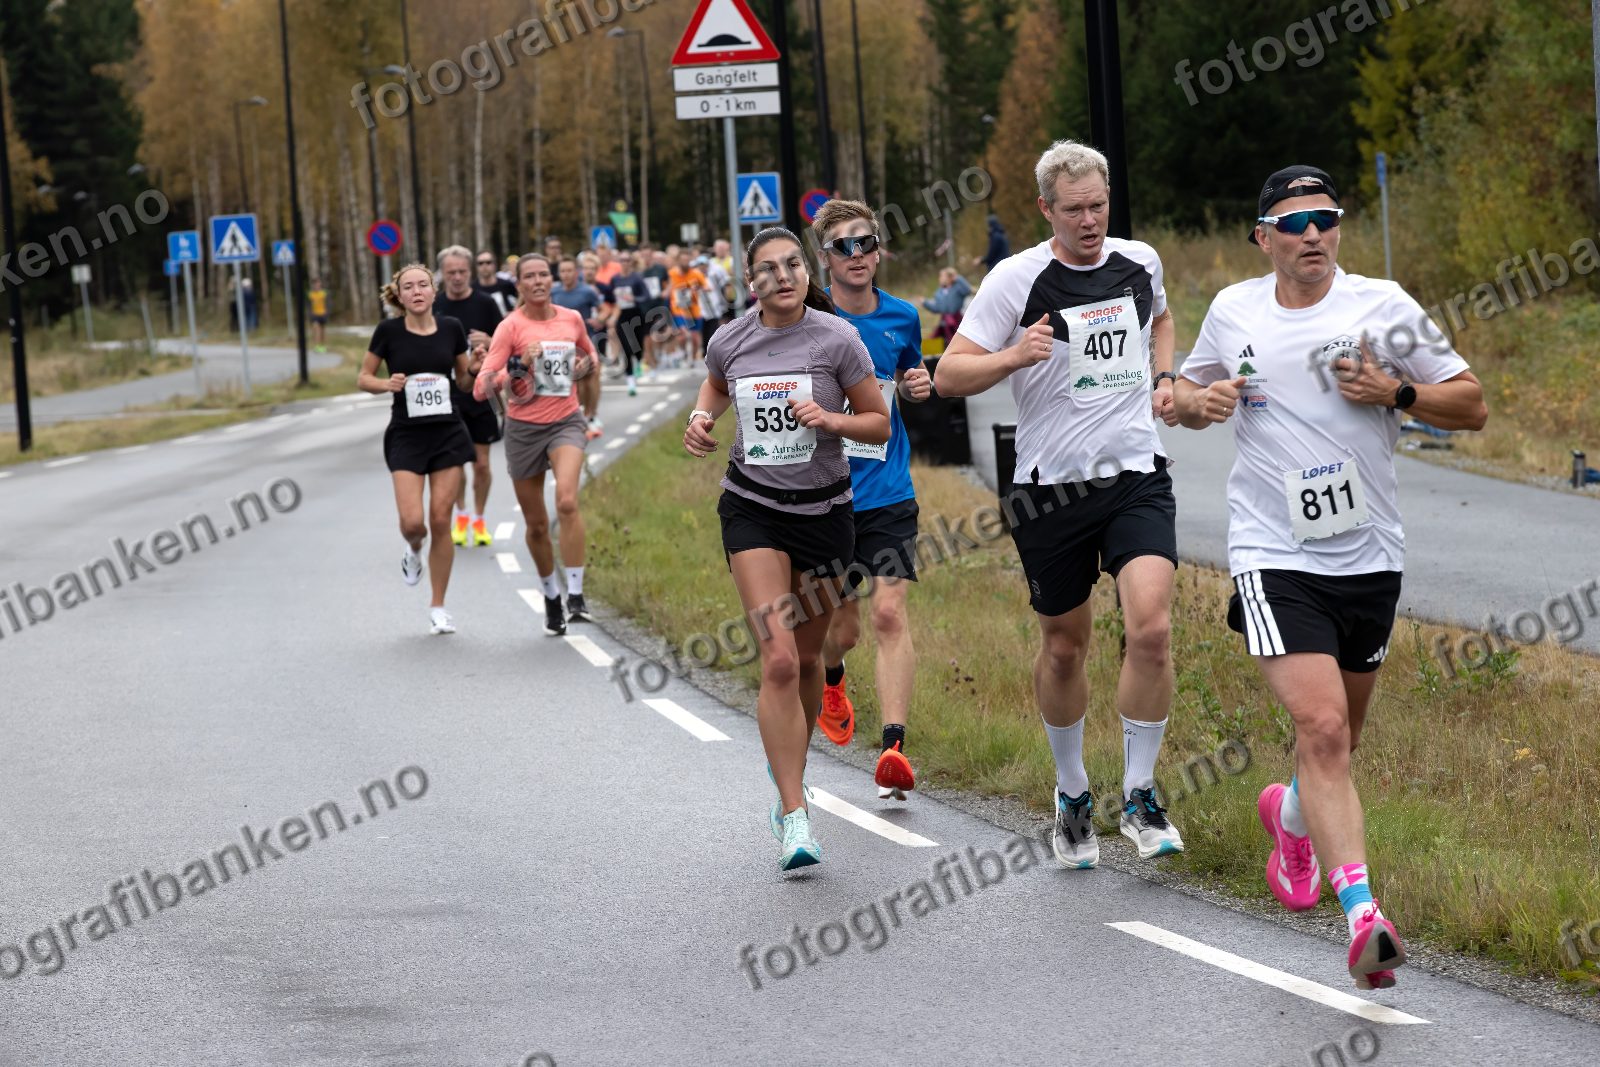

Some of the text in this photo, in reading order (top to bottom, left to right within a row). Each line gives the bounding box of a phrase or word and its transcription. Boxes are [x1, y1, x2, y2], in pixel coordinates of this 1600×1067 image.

[695, 70, 757, 87] Gangfelt
[700, 100, 710, 113] 0
[1080, 305, 1123, 320] NORGES
[1088, 314, 1119, 327] LØPET
[1084, 329, 1128, 361] 407
[543, 359, 570, 377] 923
[1102, 370, 1143, 384] Aurskog
[753, 381, 798, 392] NORGES
[415, 389, 443, 407] 496
[756, 390, 791, 401] LØPET
[754, 405, 799, 433] 539
[772, 442, 814, 455] Aurskog
[1302, 462, 1344, 480] LØPET
[1301, 480, 1354, 521] 811
